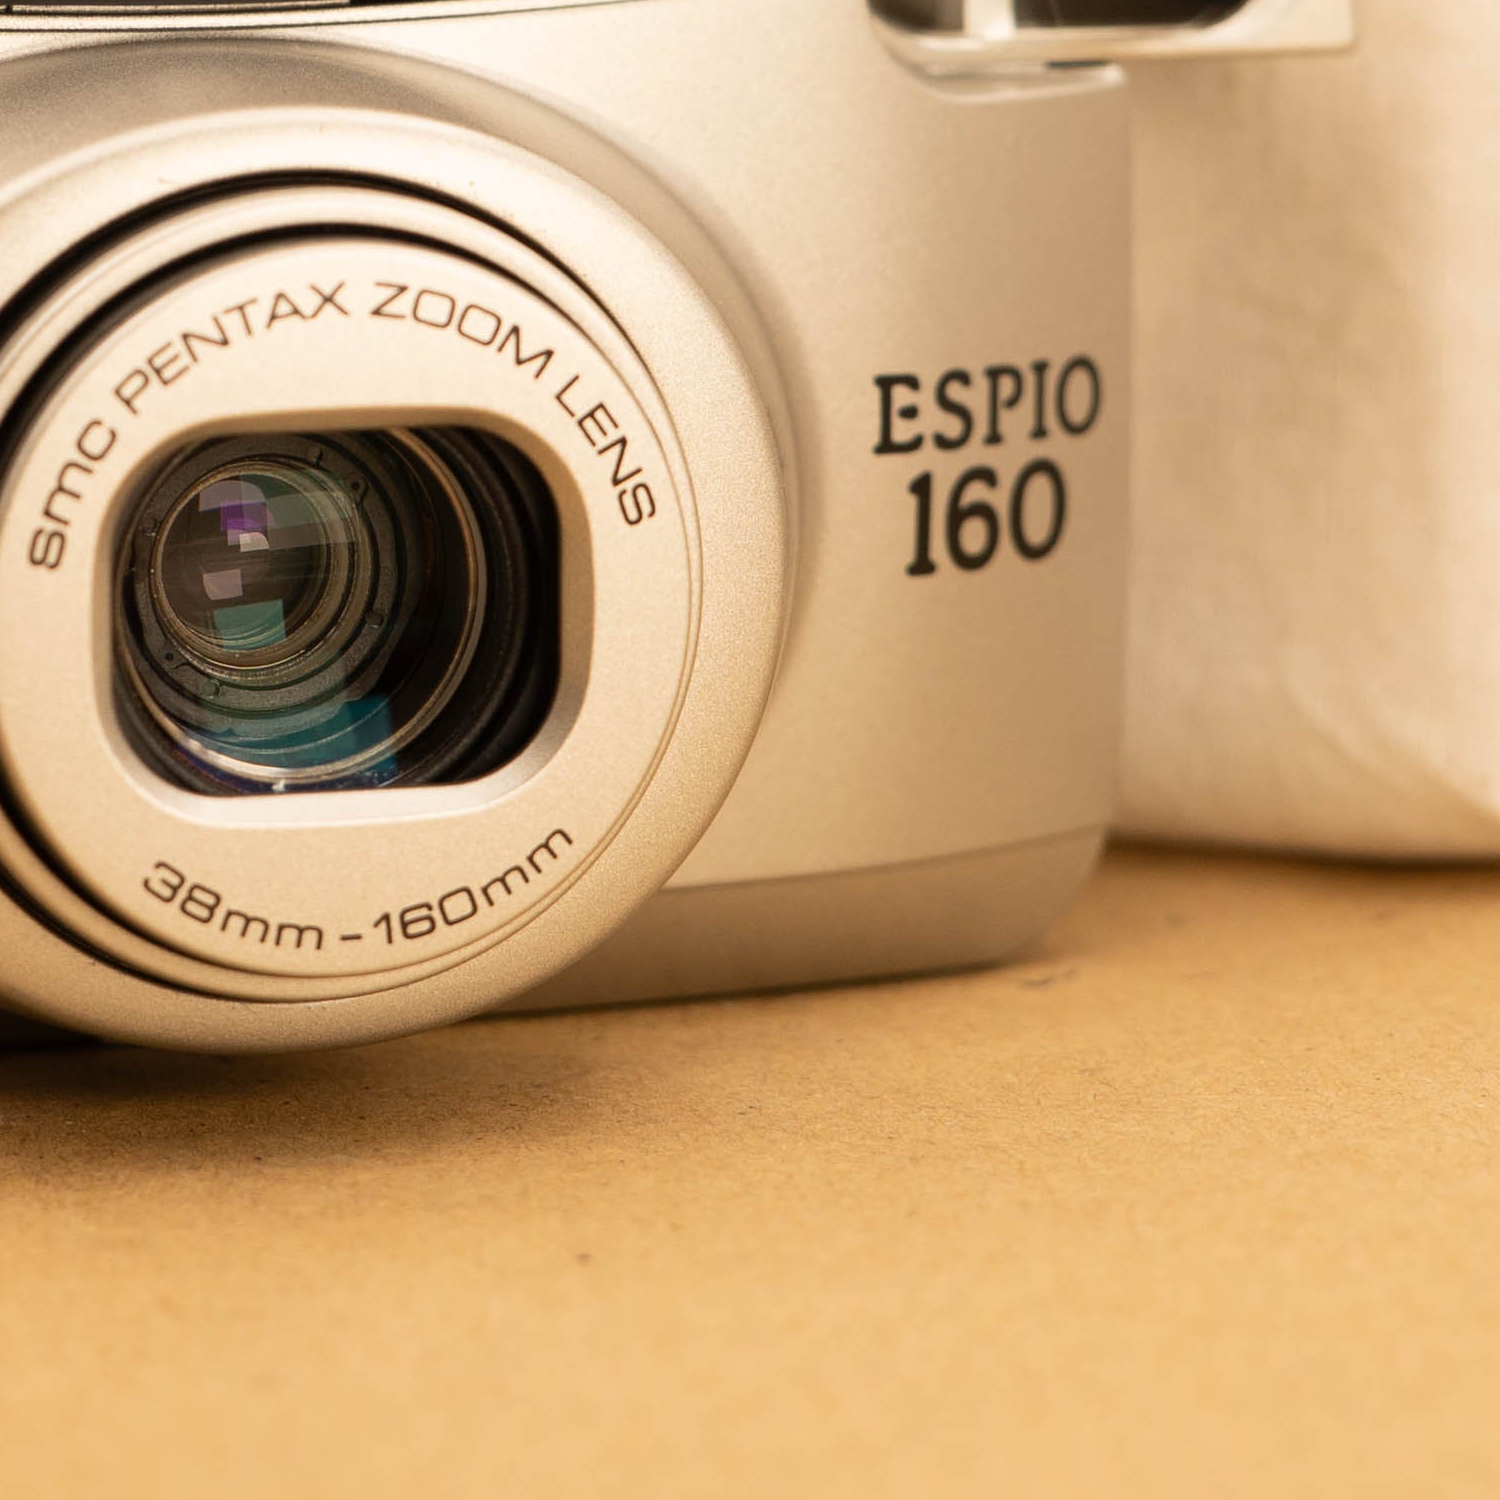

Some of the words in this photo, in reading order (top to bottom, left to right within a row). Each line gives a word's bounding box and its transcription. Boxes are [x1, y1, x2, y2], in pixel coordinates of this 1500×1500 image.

[114, 281, 350, 414] PENTAX
[370, 281, 555, 380] ZOOM
[554, 374, 656, 528] LENS
[872, 354, 1101, 456] ESPIO
[905, 457, 1067, 577] 160
